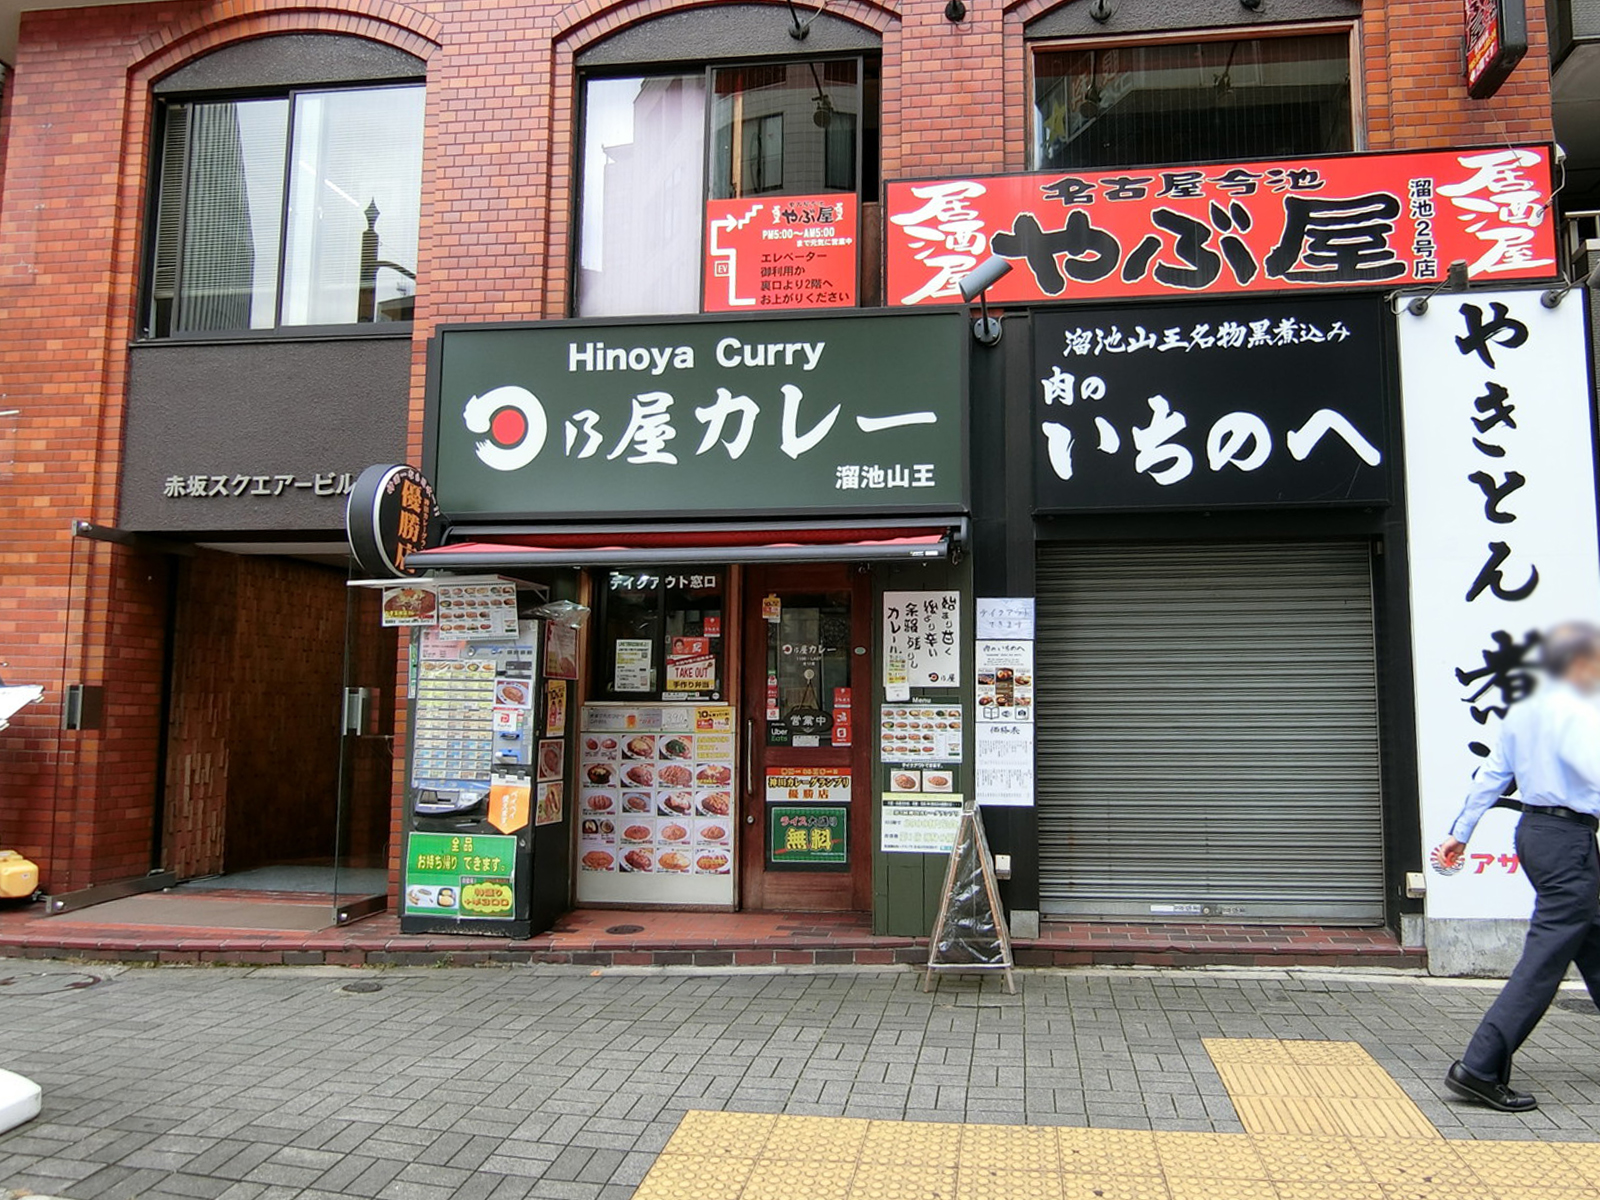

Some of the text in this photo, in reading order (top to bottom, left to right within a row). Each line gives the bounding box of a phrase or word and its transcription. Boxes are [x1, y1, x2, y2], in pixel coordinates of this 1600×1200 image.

[1041, 167, 1325, 206] 名古屋今池
[781, 206, 834, 225] やぶ屋
[1436, 149, 1554, 278] 居酒屋
[1408, 178, 1438, 279] 溜池2号店
[990, 191, 1407, 297] やぶ屋
[761, 251, 827, 263] エレベーター
[717, 264, 729, 273] EV
[760, 278, 833, 291] 裏口より2階へ
[760, 291, 850, 306] お上がりください
[1063, 317, 1351, 357] 溜池山王名物黒煮込み
[568, 337, 826, 376] Hinoya Curry
[1041, 366, 1106, 406] 肉の
[1041, 394, 1382, 486] いちのへ
[163, 472, 356, 498] 赤坂スクエアービル
[835, 463, 936, 490] 溜池山王
[610, 573, 716, 591] テイクアウト窓口
[675, 667, 709, 678] TAKE OUT
[912, 696, 932, 704] Menu
[790, 715, 827, 726] 営業中
[771, 728, 788, 736] Uber
[786, 828, 832, 851] 無料
[417, 855, 458, 870] お持ち帰り
